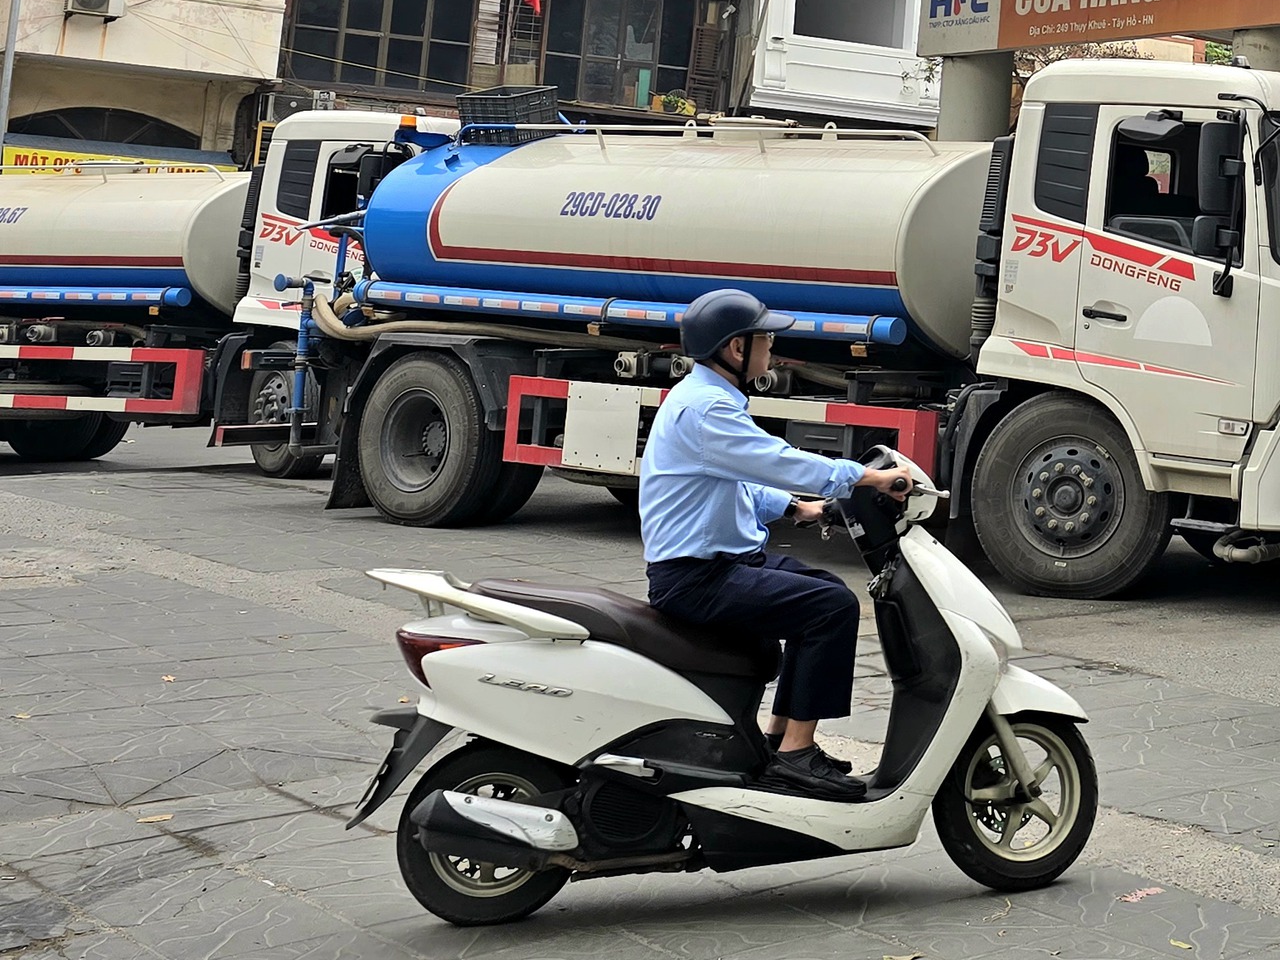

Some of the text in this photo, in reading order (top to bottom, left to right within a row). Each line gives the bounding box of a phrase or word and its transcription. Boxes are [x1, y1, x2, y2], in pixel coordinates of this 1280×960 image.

[1029, 25, 1040, 37] Địa
[1056, 23, 1069, 33] 249
[1070, 22, 1087, 33] Thụy
[1088, 19, 1106, 30] Khuê
[1112, 18, 1125, 29] Tây
[1126, 14, 1137, 27] Hồ
[1143, 15, 1154, 25] HN
[14, 152, 49, 174] MẬT
[560, 192, 662, 221] 29CD-028.30
[309, 239, 365, 262] DONGENG
[1090, 254, 1182, 292] DONGFENG
[478, 672, 573, 698] LEAD
